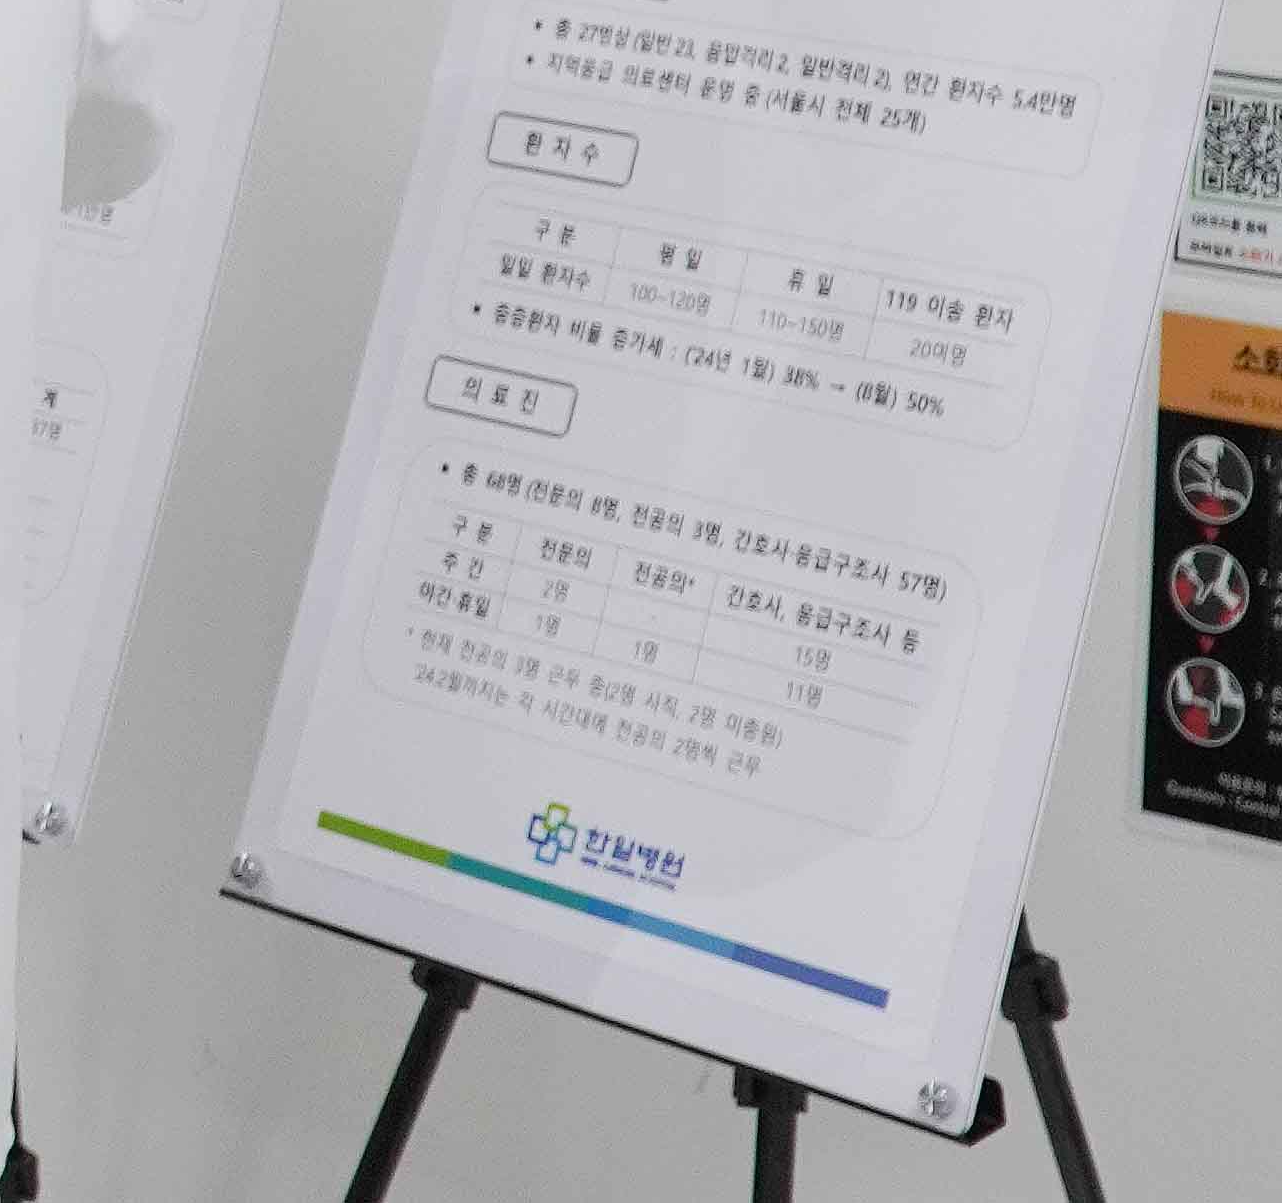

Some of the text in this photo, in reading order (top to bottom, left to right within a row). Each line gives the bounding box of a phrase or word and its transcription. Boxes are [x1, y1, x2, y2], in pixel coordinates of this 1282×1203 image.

[622, 63, 692, 98] 의료센터
[700, 75, 735, 103] 운영
[835, 96, 873, 126] 전체
[903, 69, 940, 96] 연간
[949, 76, 1004, 107] 환자수
[540, 261, 591, 293] 환자수
[886, 289, 1015, 334] 119 이송 환자
[907, 389, 946, 418] 50%
[541, 537, 593, 570] 전문의
[898, 570, 949, 604] 57명)
[795, 601, 892, 648] 응급구조사
